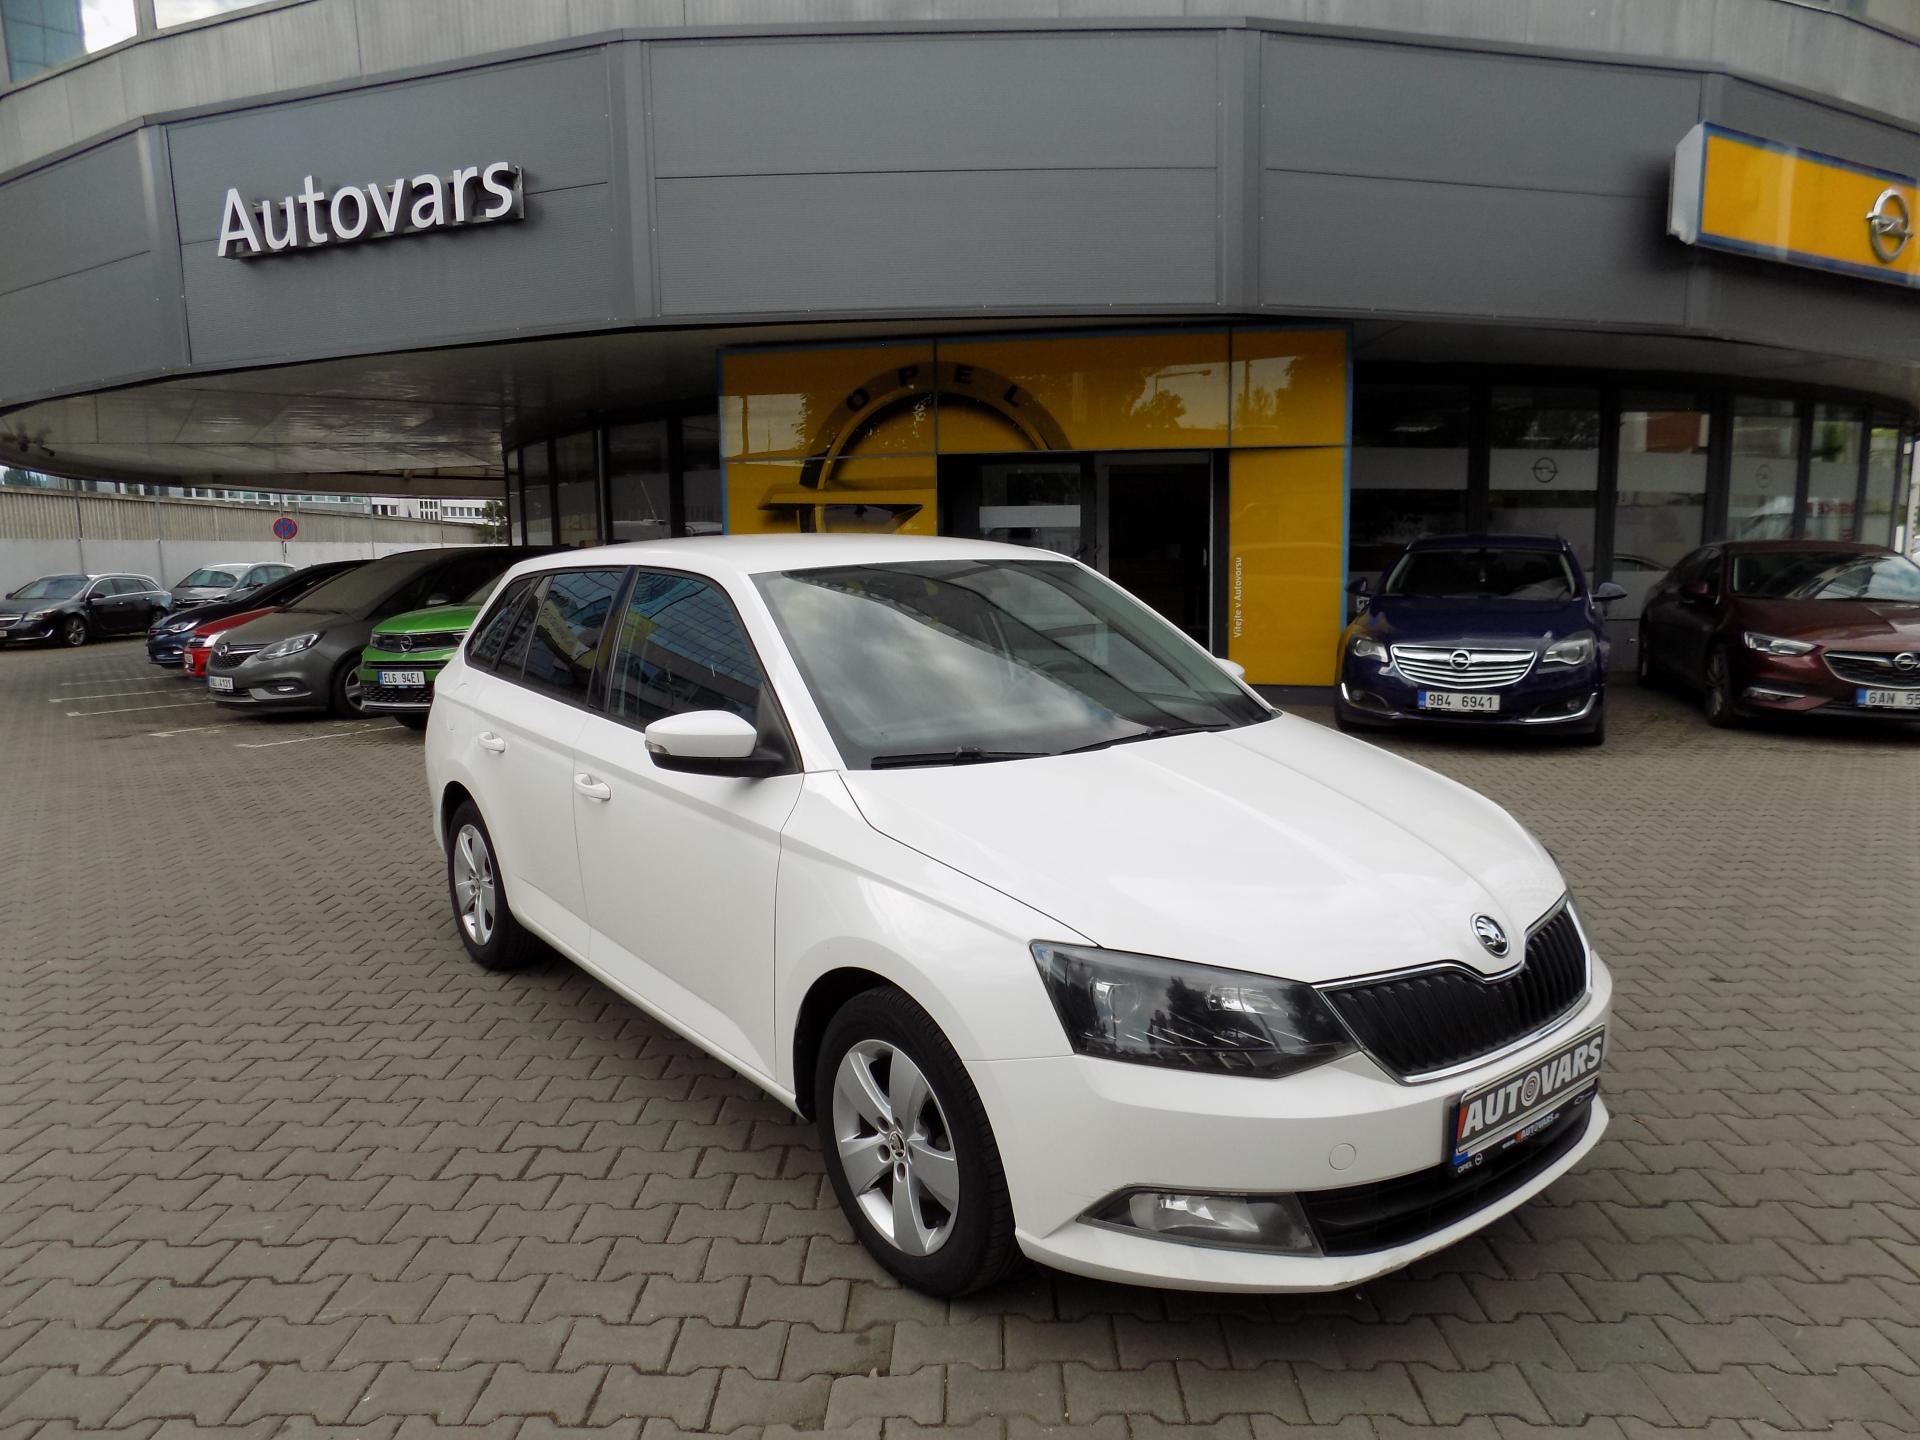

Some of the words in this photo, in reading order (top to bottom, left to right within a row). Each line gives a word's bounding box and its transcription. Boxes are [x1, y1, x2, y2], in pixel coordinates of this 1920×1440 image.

[217, 161, 513, 257] Autovars
[846, 364, 1021, 412] OPEL
[1234, 557, 1242, 601] Autovarsu
[1429, 694, 1452, 707] 9B4
[1461, 696, 1494, 709] 6941
[1869, 691, 1896, 704] 6AN
[1461, 1036, 1602, 1138] AUTOVARS
